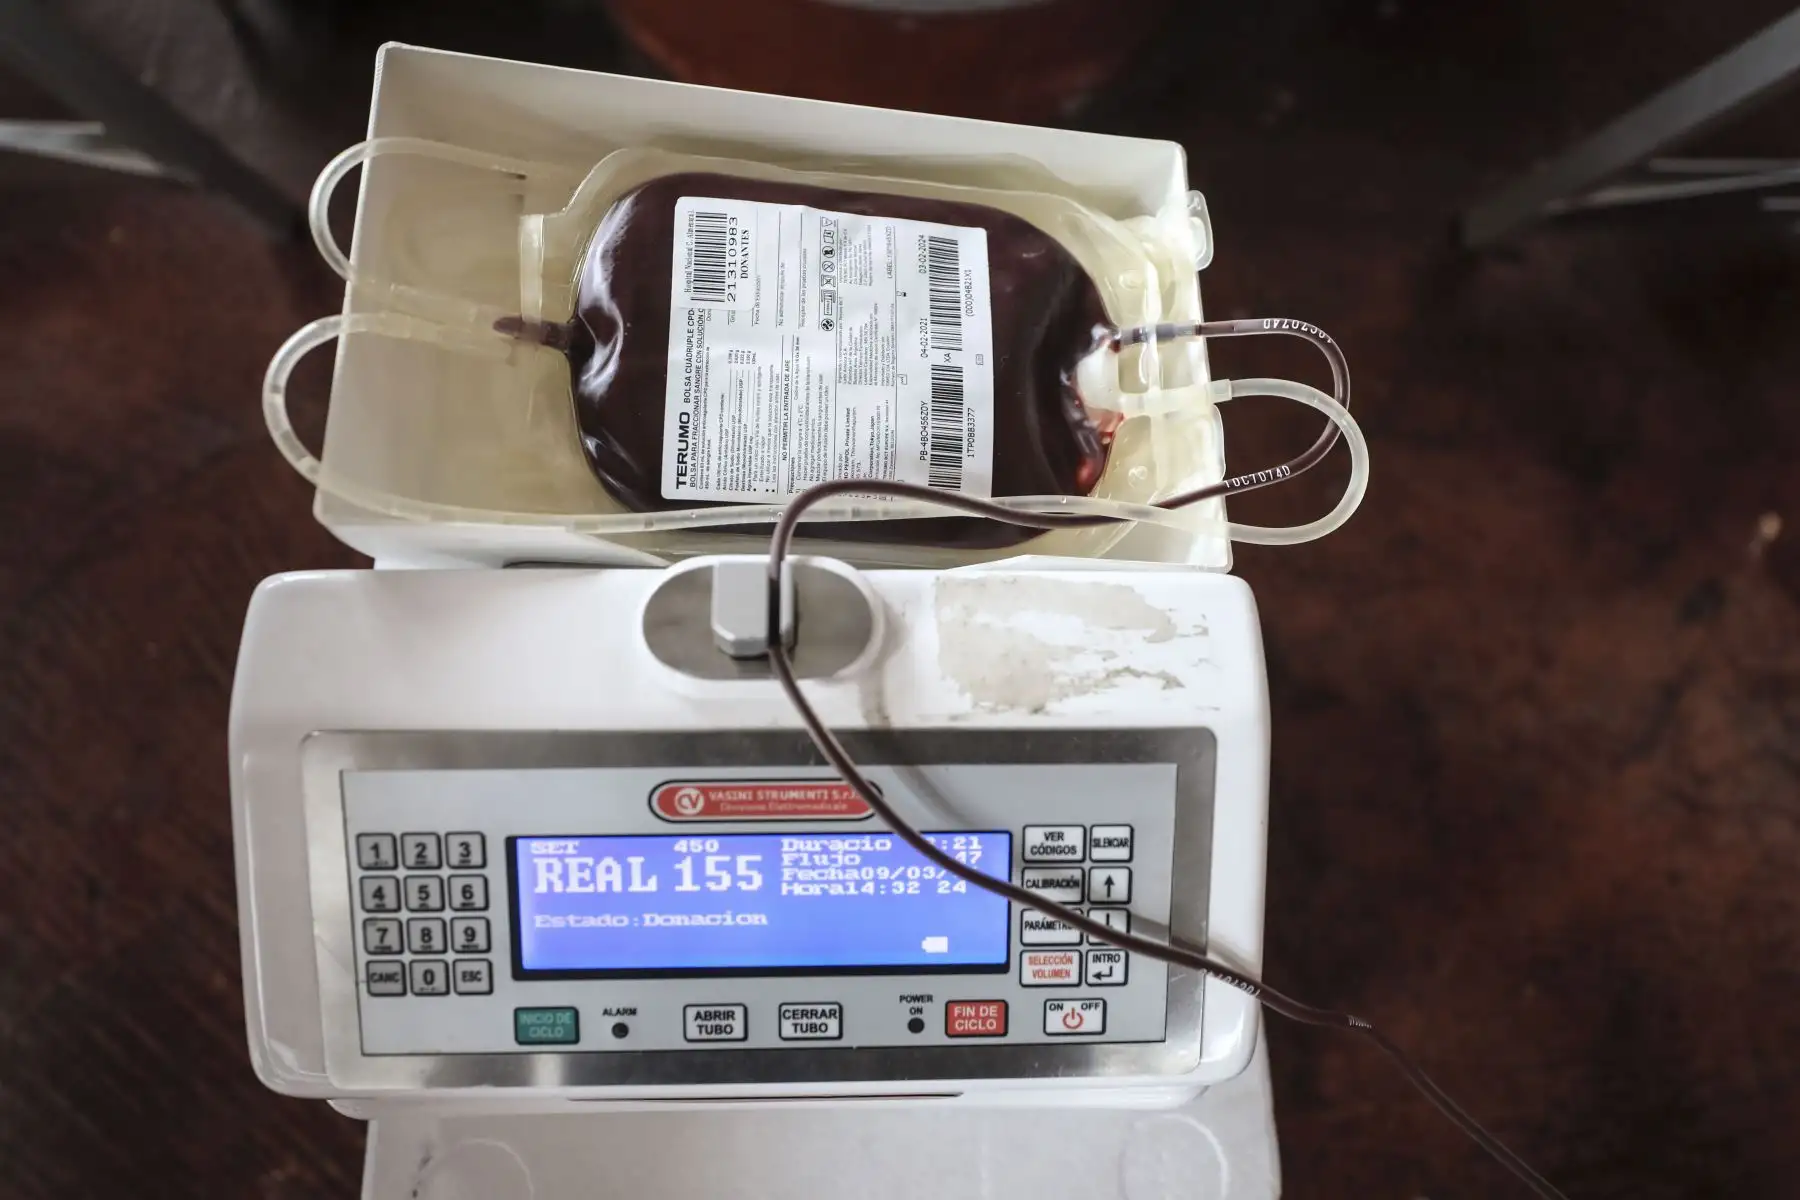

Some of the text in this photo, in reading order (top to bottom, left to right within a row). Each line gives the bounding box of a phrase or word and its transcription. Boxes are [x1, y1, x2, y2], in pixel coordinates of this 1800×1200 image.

[727, 217, 737, 302] 21310983
[740, 229, 749, 279] DONANTES
[918, 234, 927, 274] 03-02-2024
[920, 318, 928, 358] 04-02-2021
[685, 329, 694, 373] CUADRUPLE
[944, 352, 951, 363] XA
[692, 395, 700, 440] FRACCIONAR
[783, 412, 788, 420] LA
[676, 412, 690, 489] TERUMO
[782, 452, 788, 461] NO
[708, 790, 752, 801] VASINI
[762, 789, 828, 800] STRUMENTI
[1044, 831, 1064, 841] VER
[1092, 837, 1130, 848] SILENCIAR
[369, 842, 381, 860] 1
[414, 842, 428, 859] 2
[459, 841, 472, 858] 3
[531, 839, 719, 855] SET 450
[781, 837, 892, 851] Duracio
[1030, 842, 1077, 856] CÓDIGOS
[781, 851, 861, 867] Flujo
[533, 855, 763, 893] REAL 155
[937, 880, 967, 894] 24
[1026, 875, 1080, 889] CALIBRACIÓN
[372, 885, 386, 901] 4
[418, 884, 430, 901] 5
[461, 884, 474, 901] 6
[375, 927, 388, 944] 7
[420, 927, 433, 944] 8
[463, 926, 476, 943] 9
[1028, 954, 1073, 966] SELECCIÓN
[1092, 953, 1121, 963] INTRO
[370, 972, 400, 983] CANC
[423, 969, 435, 985] 0
[461, 970, 482, 983] ESC
[1032, 969, 1071, 980] VOLUMEN
[899, 994, 934, 1004] POWER
[602, 1007, 638, 1017] ALARM
[909, 1007, 923, 1016] ON
[953, 1006, 998, 1018] FIN DE
[1049, 1001, 1101, 1012] ON OFF
[556, 1012, 572, 1025] DE
[694, 1010, 736, 1022] ABRIR
[782, 1008, 838, 1020] CERRAR
[696, 1024, 734, 1036] TUBO
[791, 1022, 828, 1034] TUBO
[955, 1019, 997, 1031] CICLO
[529, 1026, 564, 1039] CICLO
